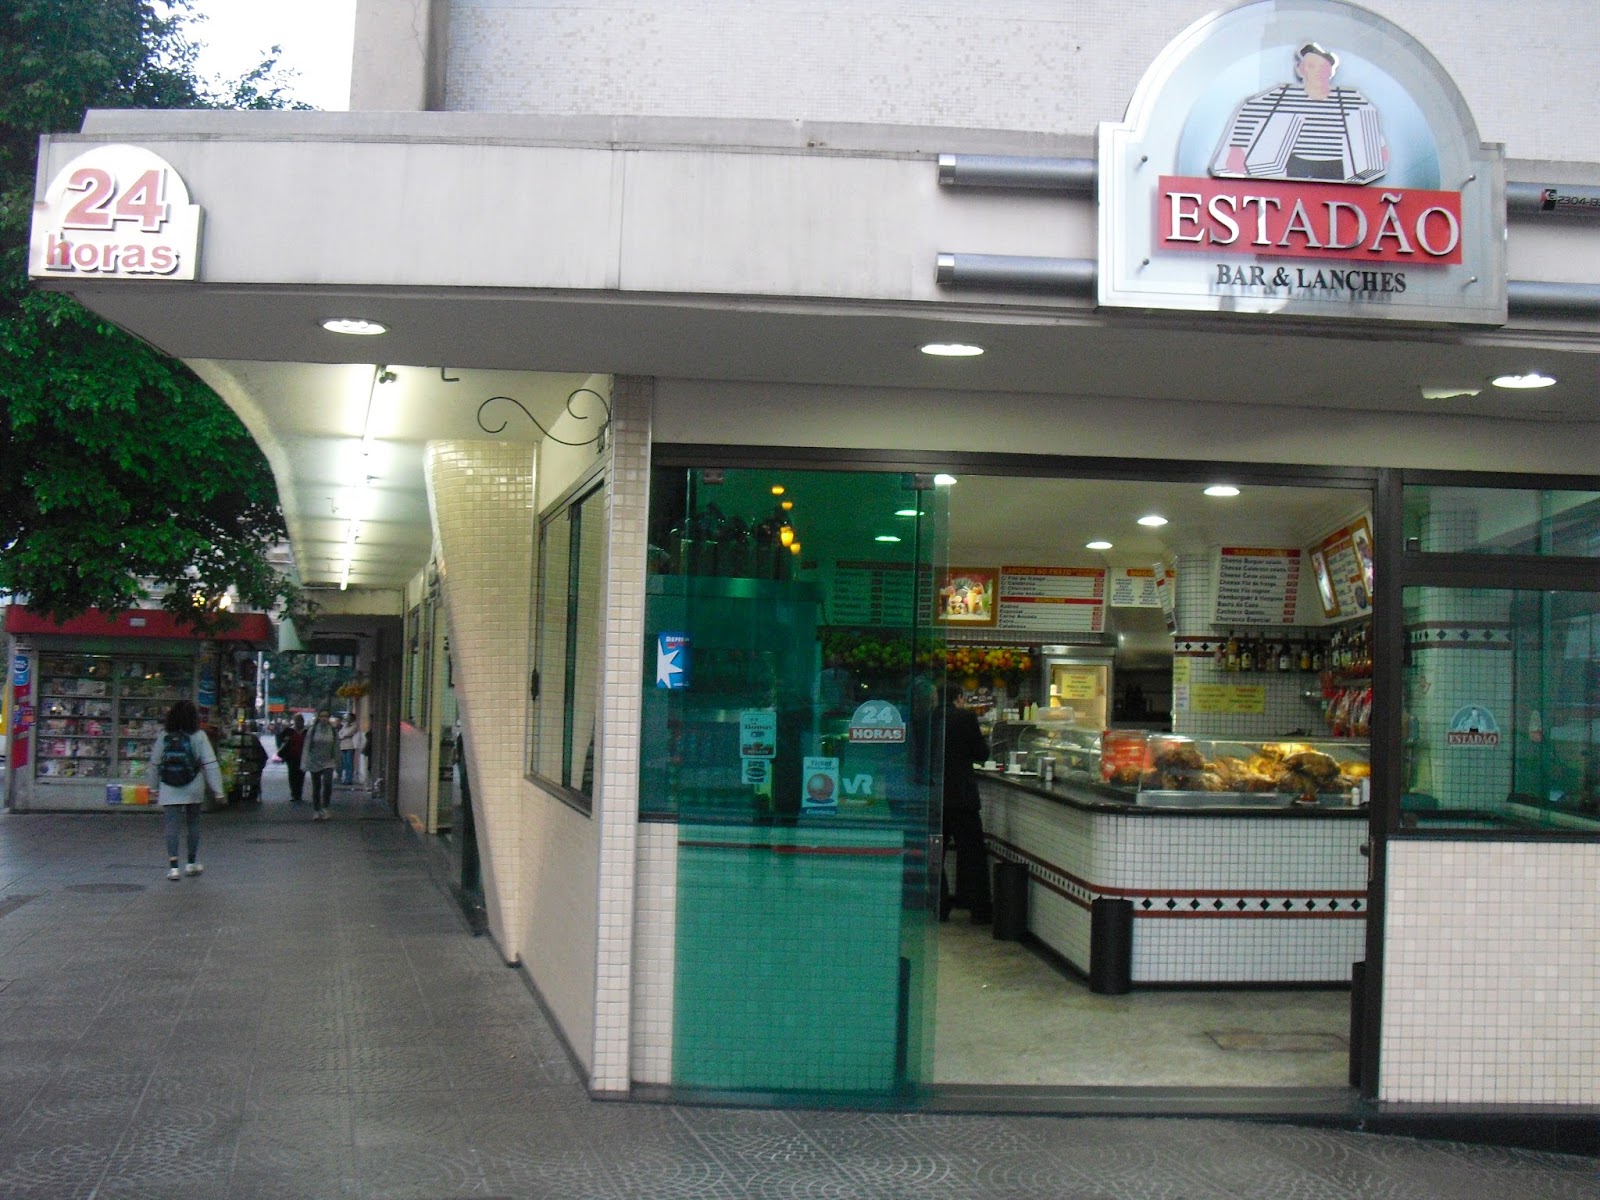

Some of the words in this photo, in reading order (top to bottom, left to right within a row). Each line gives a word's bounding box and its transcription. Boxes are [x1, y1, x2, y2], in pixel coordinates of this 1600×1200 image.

[63, 168, 165, 227] 24
[1165, 191, 1460, 256] ESTADÃO
[46, 234, 174, 270] horas
[1217, 263, 1267, 286] BAR
[1272, 266, 1291, 288] &
[1296, 268, 1407, 293] LANCHES
[861, 706, 894, 724] 24
[852, 728, 902, 740] HORAS
